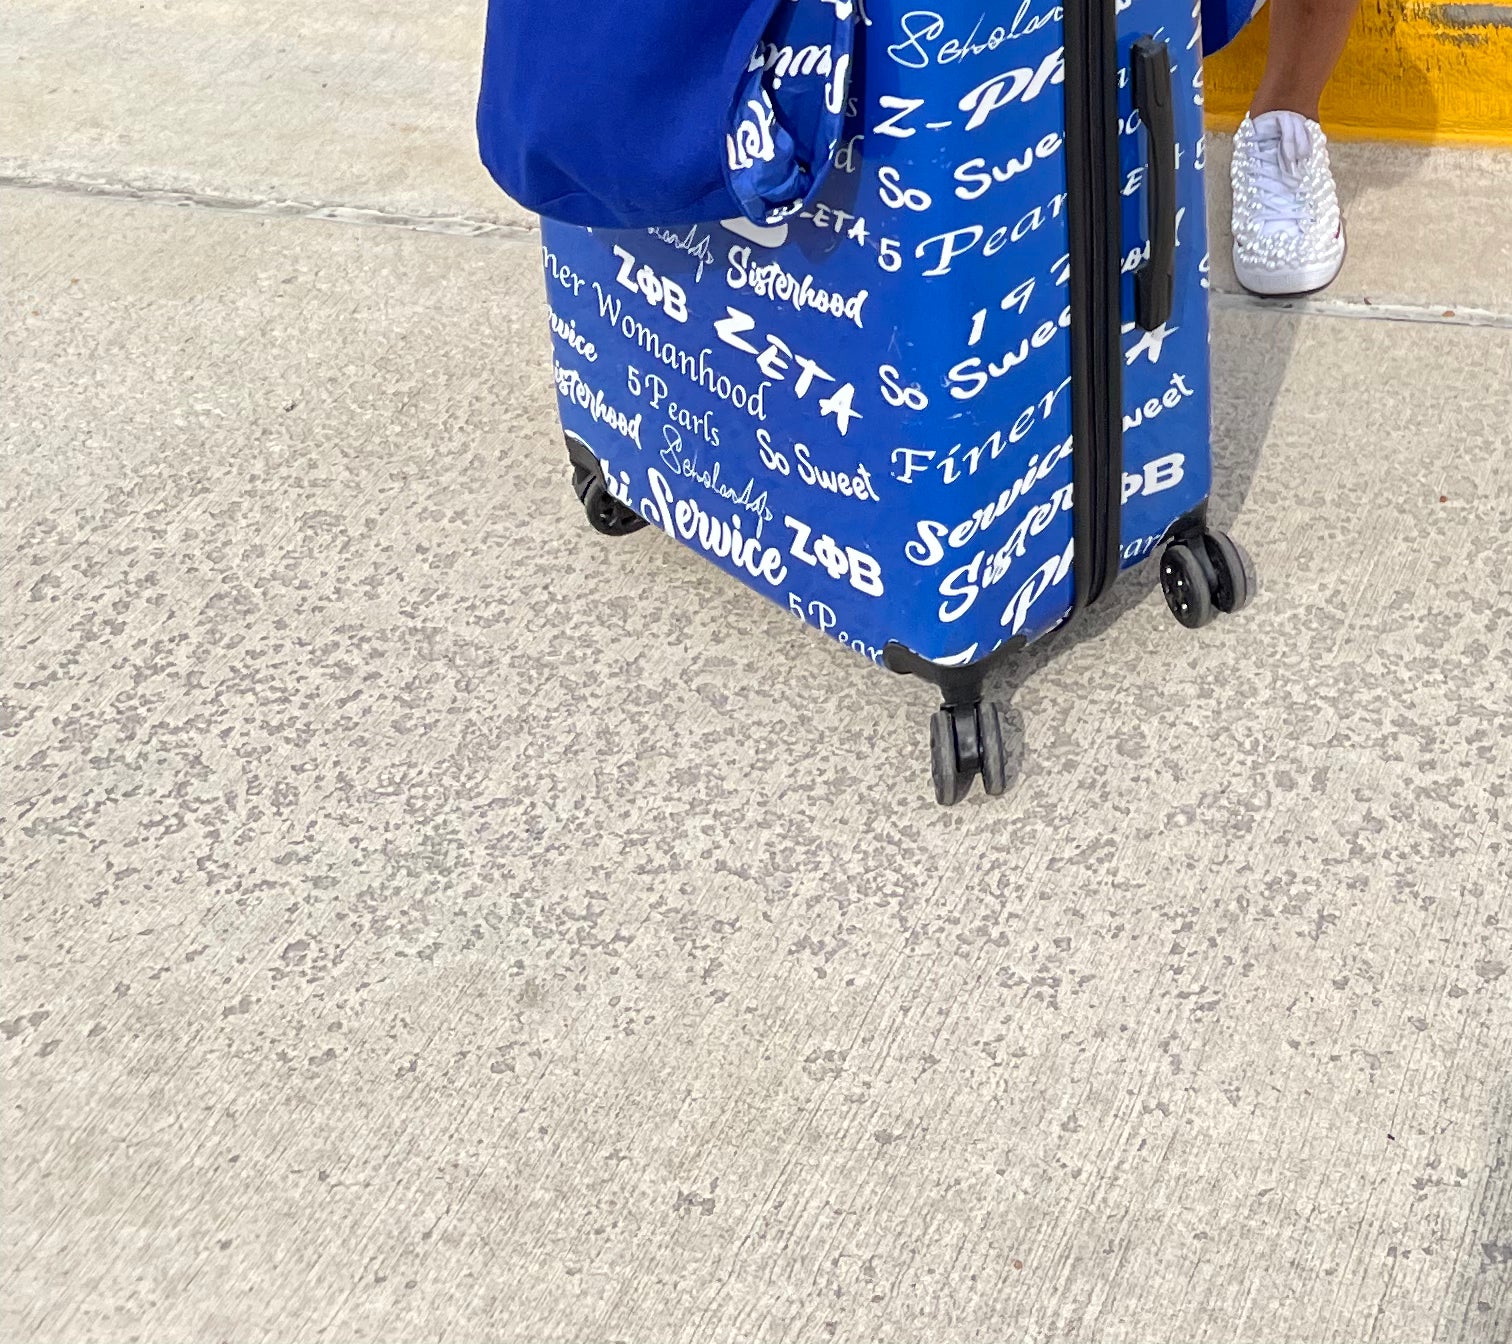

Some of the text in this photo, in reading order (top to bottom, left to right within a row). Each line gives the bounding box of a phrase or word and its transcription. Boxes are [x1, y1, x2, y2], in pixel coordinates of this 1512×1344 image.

[800, 202, 869, 247] ETA
[878, 166, 932, 211] So
[726, 245, 868, 328] Sisterhood
[878, 238, 902, 273] 5
[592, 281, 772, 421] Womanhood
[713, 306, 863, 437] ZETA
[878, 364, 929, 411] So
[627, 364, 720, 447] 5 Pearls
[756, 428, 880, 502] So Sweet
